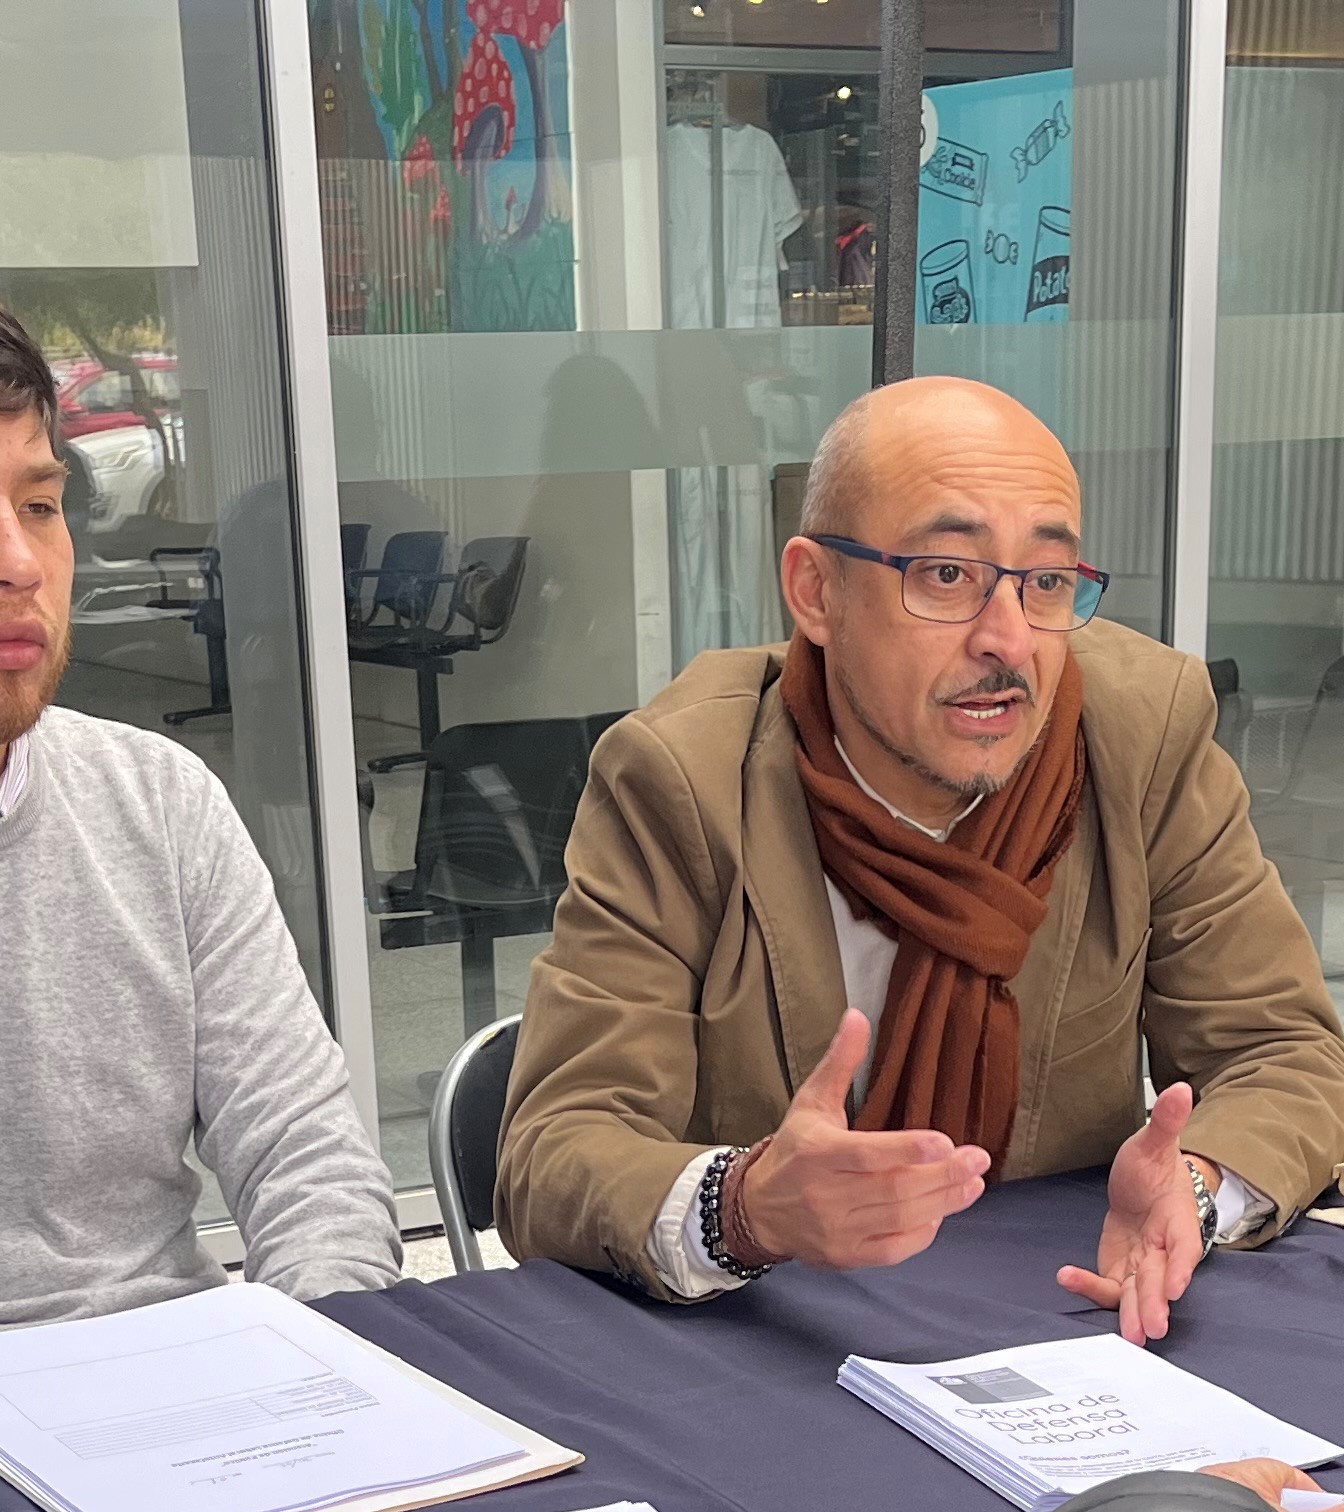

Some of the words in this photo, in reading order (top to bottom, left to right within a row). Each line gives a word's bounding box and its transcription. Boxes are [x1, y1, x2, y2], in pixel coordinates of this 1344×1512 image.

[955, 1402, 1072, 1420] Oficina
[1077, 1394, 1121, 1409] de
[986, 1407, 1128, 1433] Defensa
[1007, 1420, 1140, 1445] Laboral
